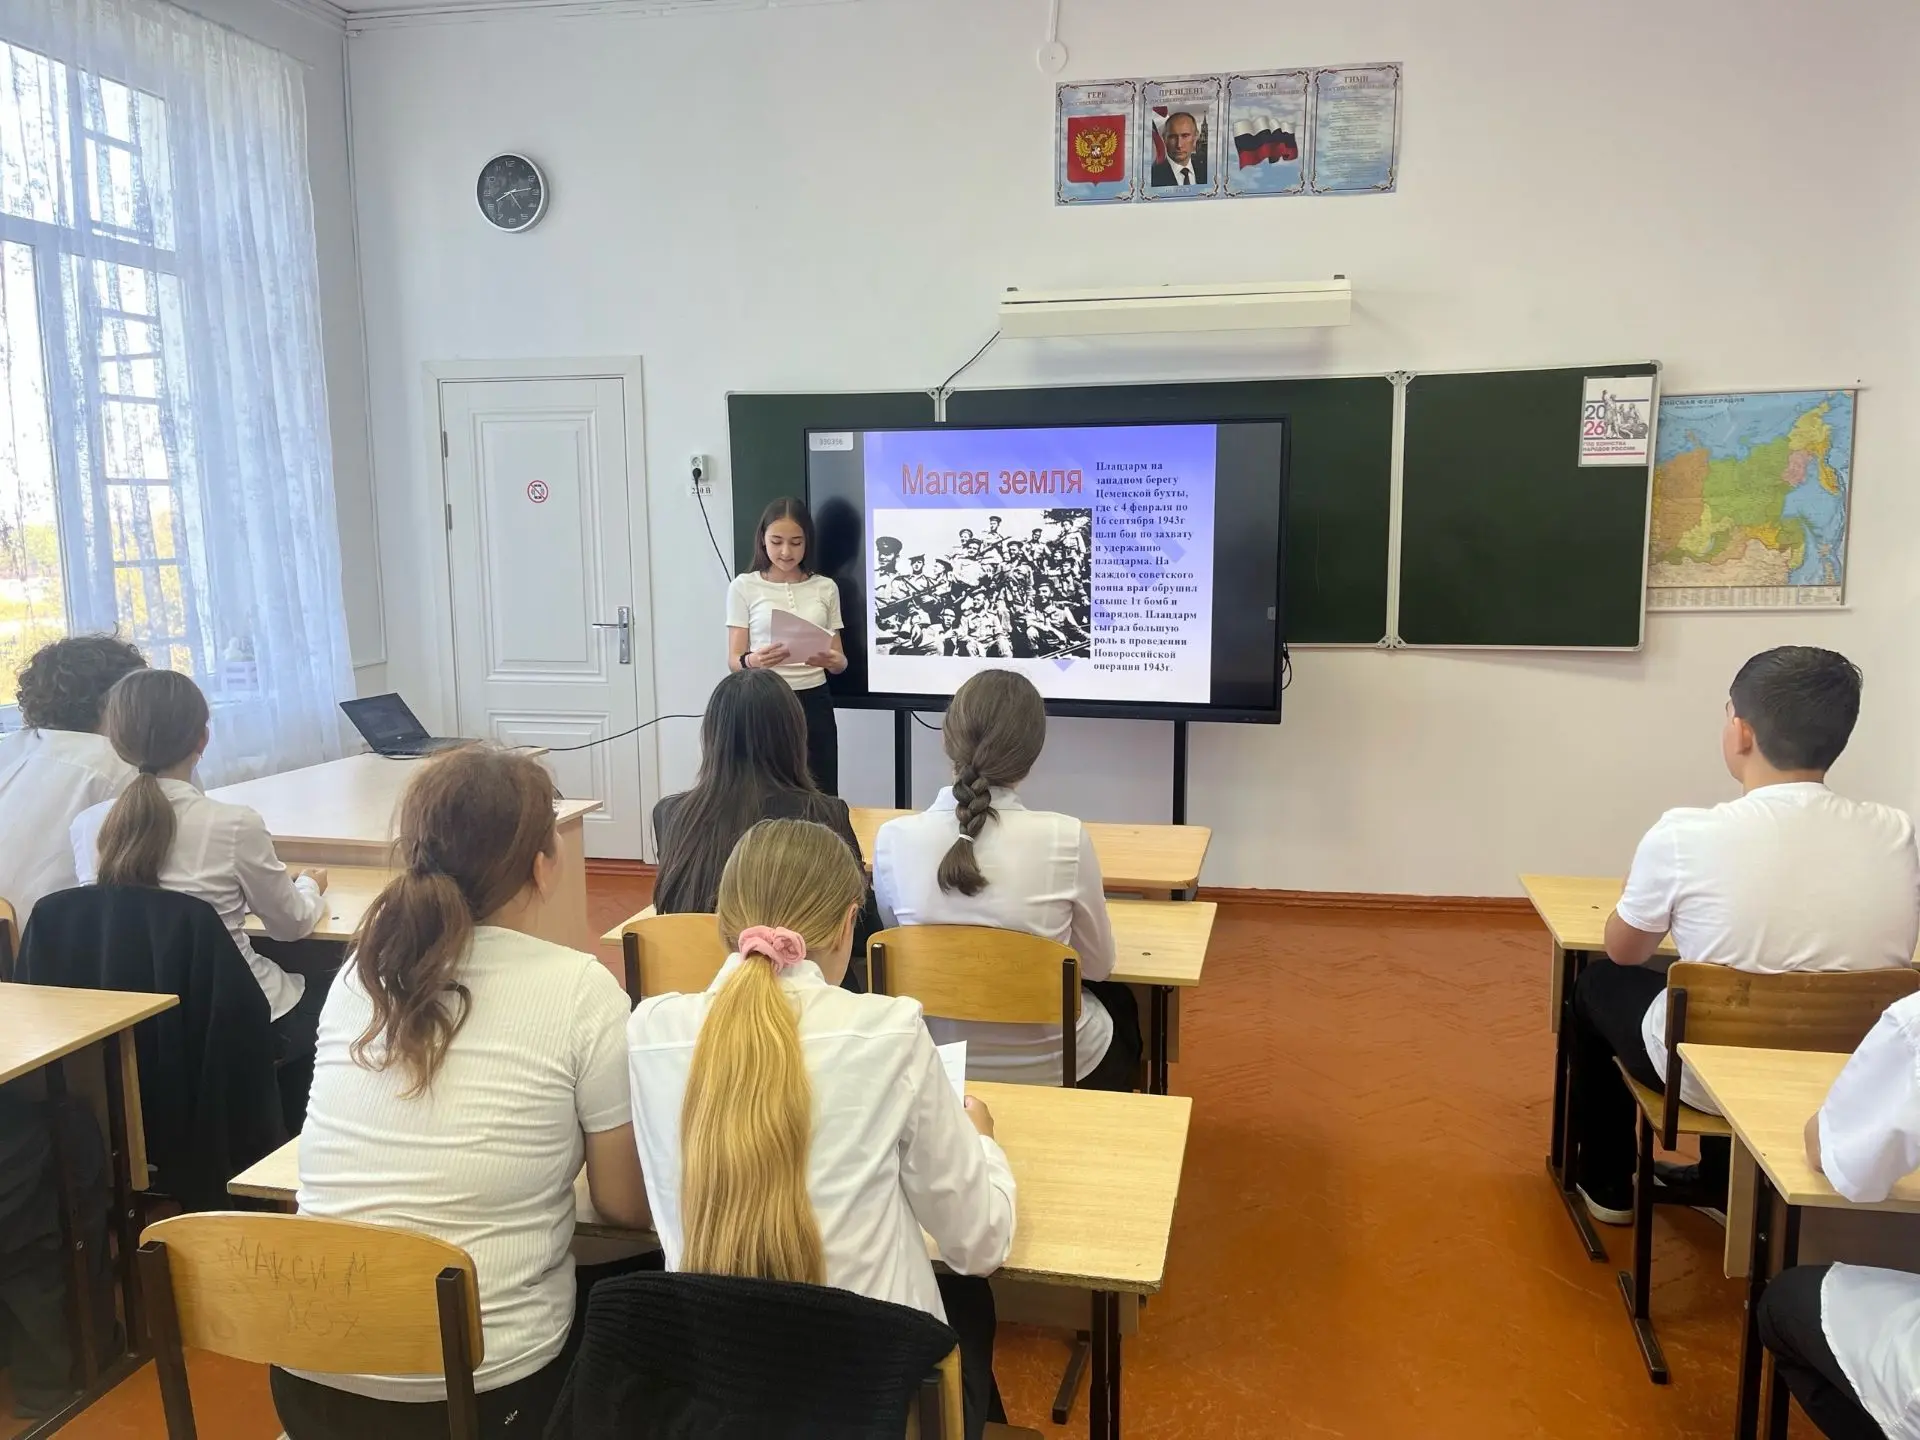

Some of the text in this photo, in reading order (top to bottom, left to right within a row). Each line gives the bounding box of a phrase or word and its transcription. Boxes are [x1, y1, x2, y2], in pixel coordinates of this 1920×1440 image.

[1159, 87, 1204, 97] ПРЕЗИДЕНТ
[1585, 404, 1606, 420] 20
[1583, 420, 1605, 436] 26
[1096, 461, 1147, 472] Плацдарм
[902, 463, 1083, 495] Малая земля
[1146, 475, 1178, 486] берегу
[1154, 488, 1189, 499] бухты,
[1095, 504, 1111, 513] где
[1121, 503, 1127, 512] 4
[1129, 502, 1172, 513] февраля
[1096, 516, 1186, 527] 16 сентября 1943г
[1095, 531, 1117, 539] шли
[1119, 529, 1137, 538] бои
[1155, 531, 1193, 540] захвату
[1104, 545, 1161, 554] удержанию
[1155, 556, 1169, 565] На
[1094, 571, 1136, 580] каждого
[1127, 585, 1149, 594] враг
[1152, 583, 1198, 595] обрушил
[1144, 597, 1169, 606] бомб
[1145, 610, 1197, 621] Плацдарм
[1094, 623, 1179, 635] сыграл большую
[1094, 637, 1117, 646] роль
[1129, 638, 1187, 647] проведении
[1094, 648, 1176, 659] Новороссийской
[1093, 663, 1140, 672] операции
